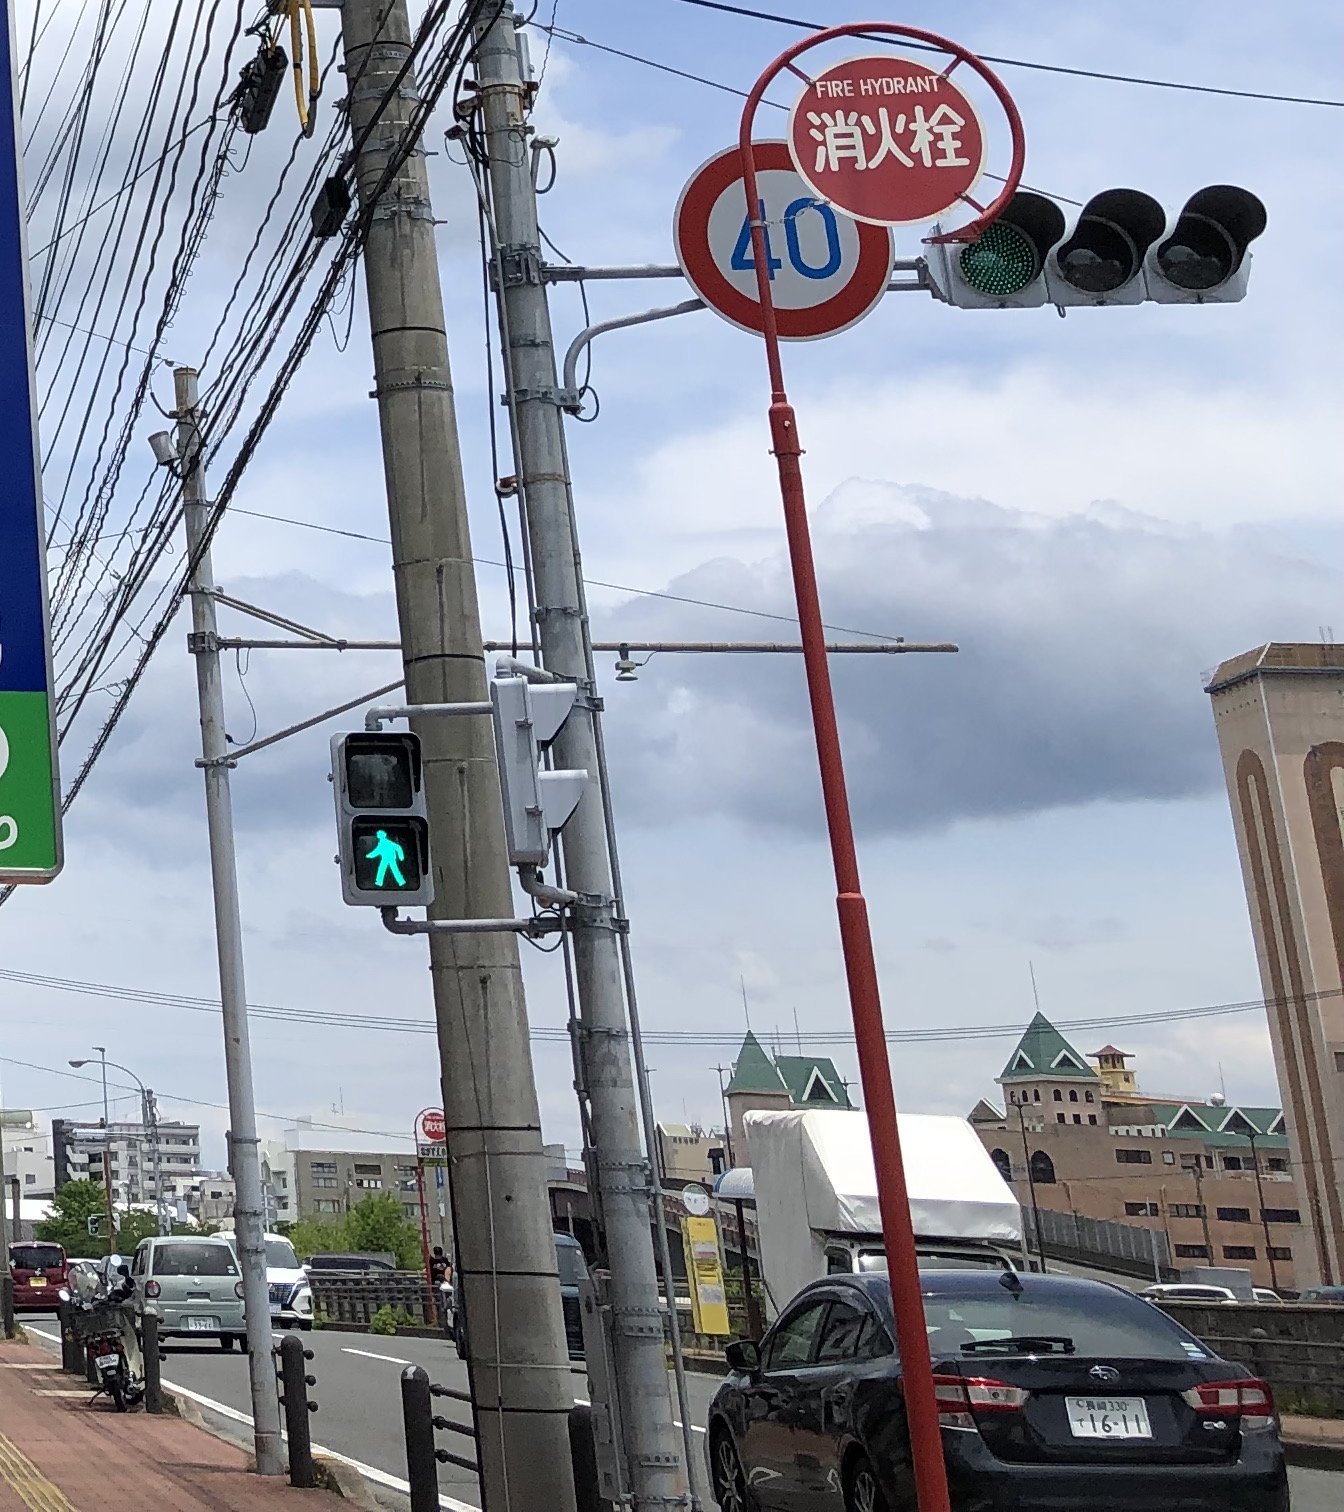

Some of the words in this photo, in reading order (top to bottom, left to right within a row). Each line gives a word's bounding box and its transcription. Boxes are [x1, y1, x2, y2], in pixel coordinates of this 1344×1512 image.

[816, 79, 855, 99] FIRE
[859, 75, 941, 96] HYDRANT
[805, 103, 972, 173] 消火栓
[730, 197, 843, 282] 40
[1089, 1413, 1143, 1434] 16-11
